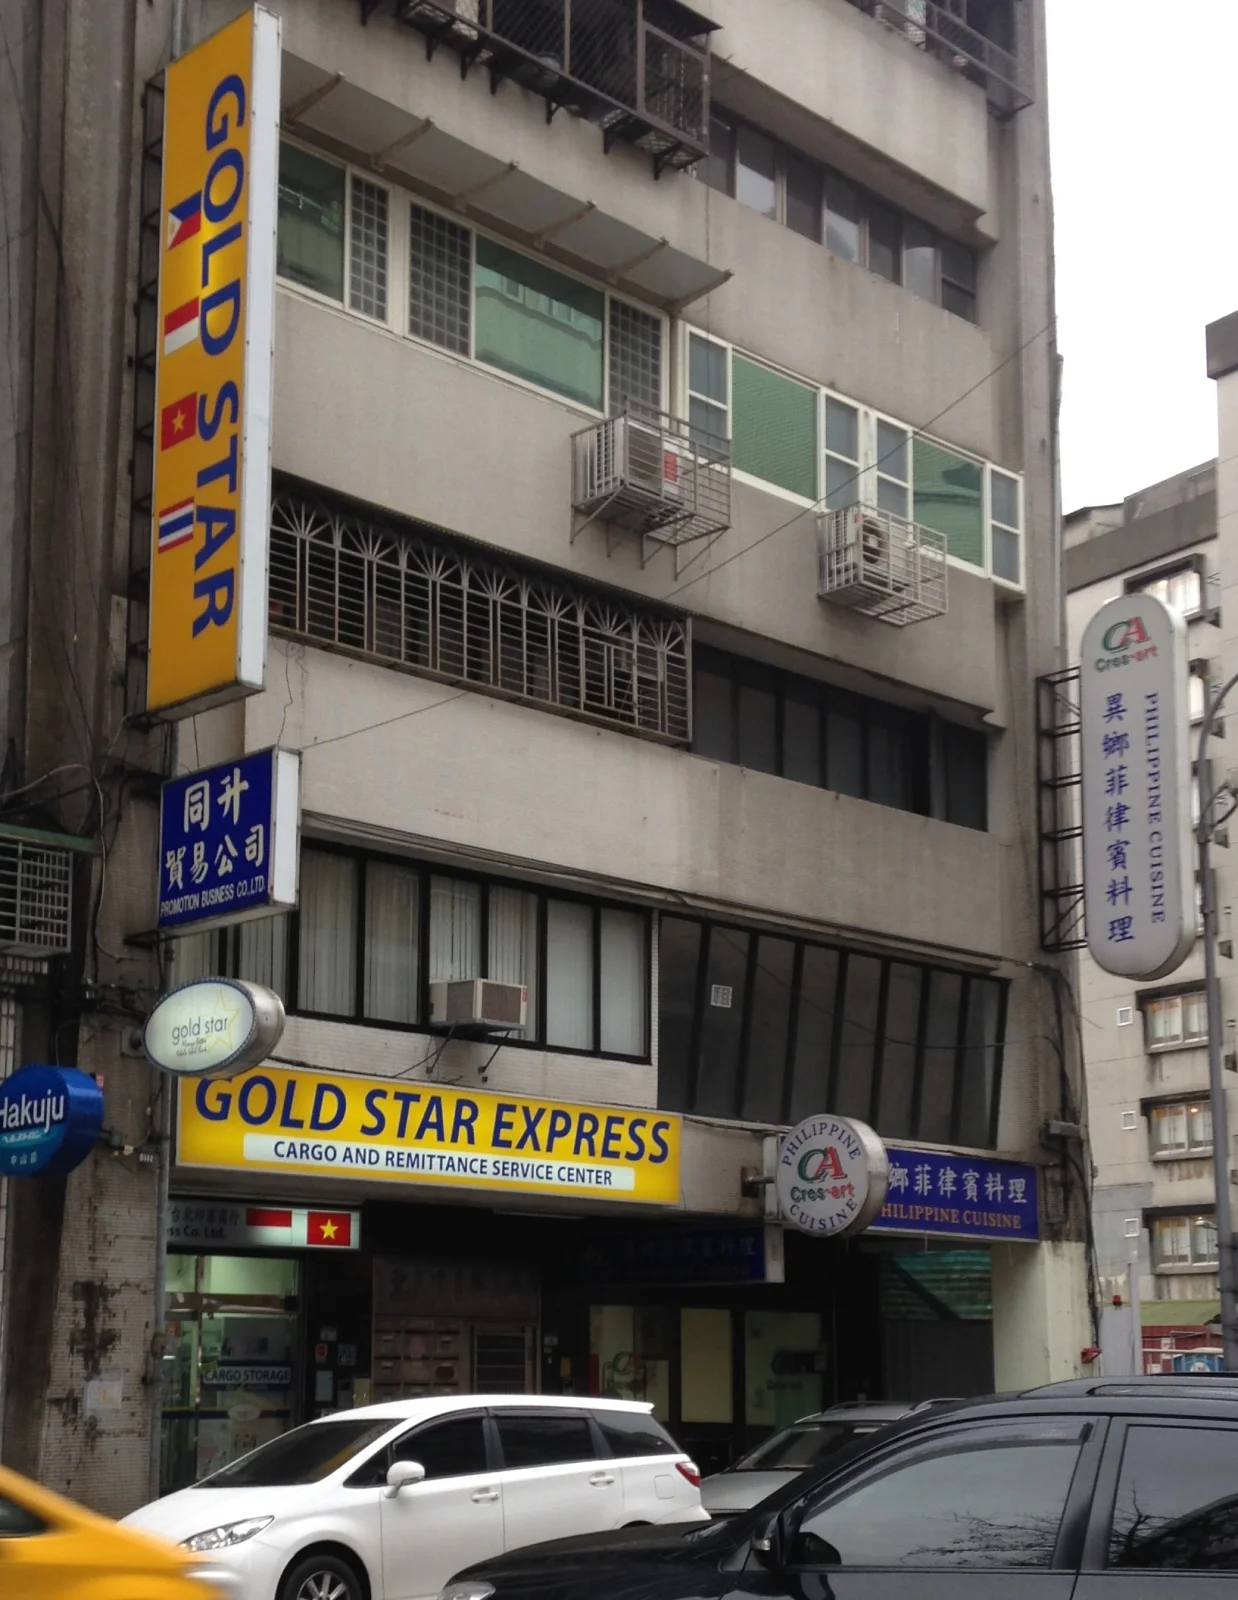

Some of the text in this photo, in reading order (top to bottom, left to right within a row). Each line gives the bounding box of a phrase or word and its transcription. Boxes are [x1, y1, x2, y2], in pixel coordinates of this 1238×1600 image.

[191, 74, 246, 639] GOLD STAR
[184, 767, 249, 833] 同升
[1102, 692, 1135, 943] 異鄉菲律賓料理
[1145, 692, 1165, 923] PHILIPPINE CUISINE
[165, 823, 264, 892] 貿易公司
[160, 890, 200, 917] PROMOTION
[201, 883, 235, 907] BUSINESS
[172, 1015, 201, 1046] gold
[205, 1016, 228, 1034] star
[195, 1075, 670, 1164] GOLD STAR EXPRESS
[273, 1141, 612, 1185] CARGO AND REMITTANCE SERVICE CENTER
[782, 1122, 861, 1166] PHILIPPINE
[797, 1145, 848, 1183] CA
[888, 1162, 1028, 1204] 鄉菲律賓料理
[790, 1198, 858, 1231] CUISINE
[881, 1203, 1022, 1230] HILIPPINE CUISINE
[204, 1366, 290, 1381] CARGO STORAGE
